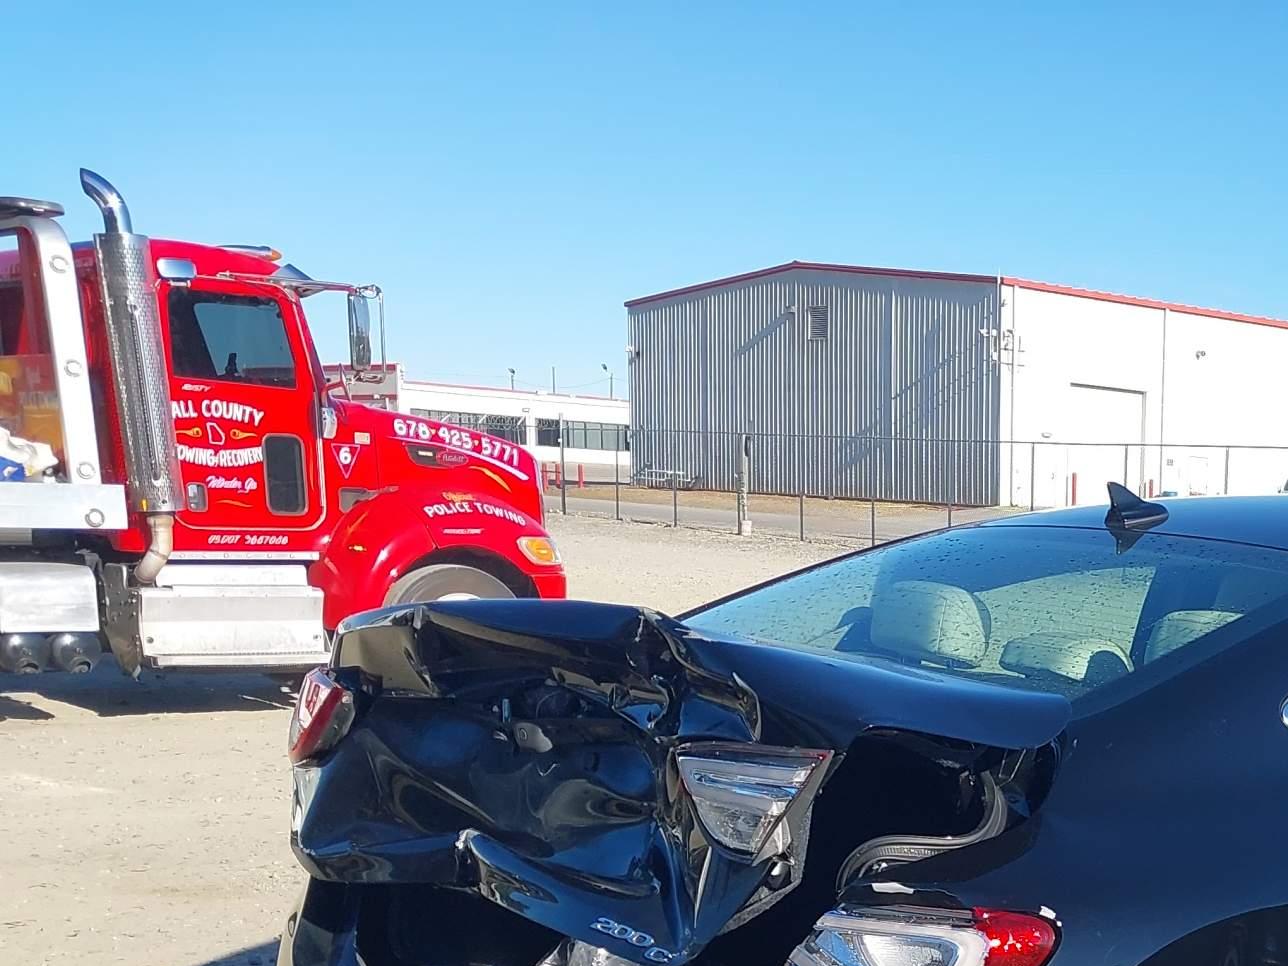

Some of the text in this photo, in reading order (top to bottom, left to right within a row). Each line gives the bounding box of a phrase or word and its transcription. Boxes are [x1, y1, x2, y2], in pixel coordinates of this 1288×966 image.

[202, 399, 265, 426] COUNTY
[340, 446, 352, 464] 6
[423, 502, 526, 526] POLICE TOWING
[590, 917, 655, 947] 200
